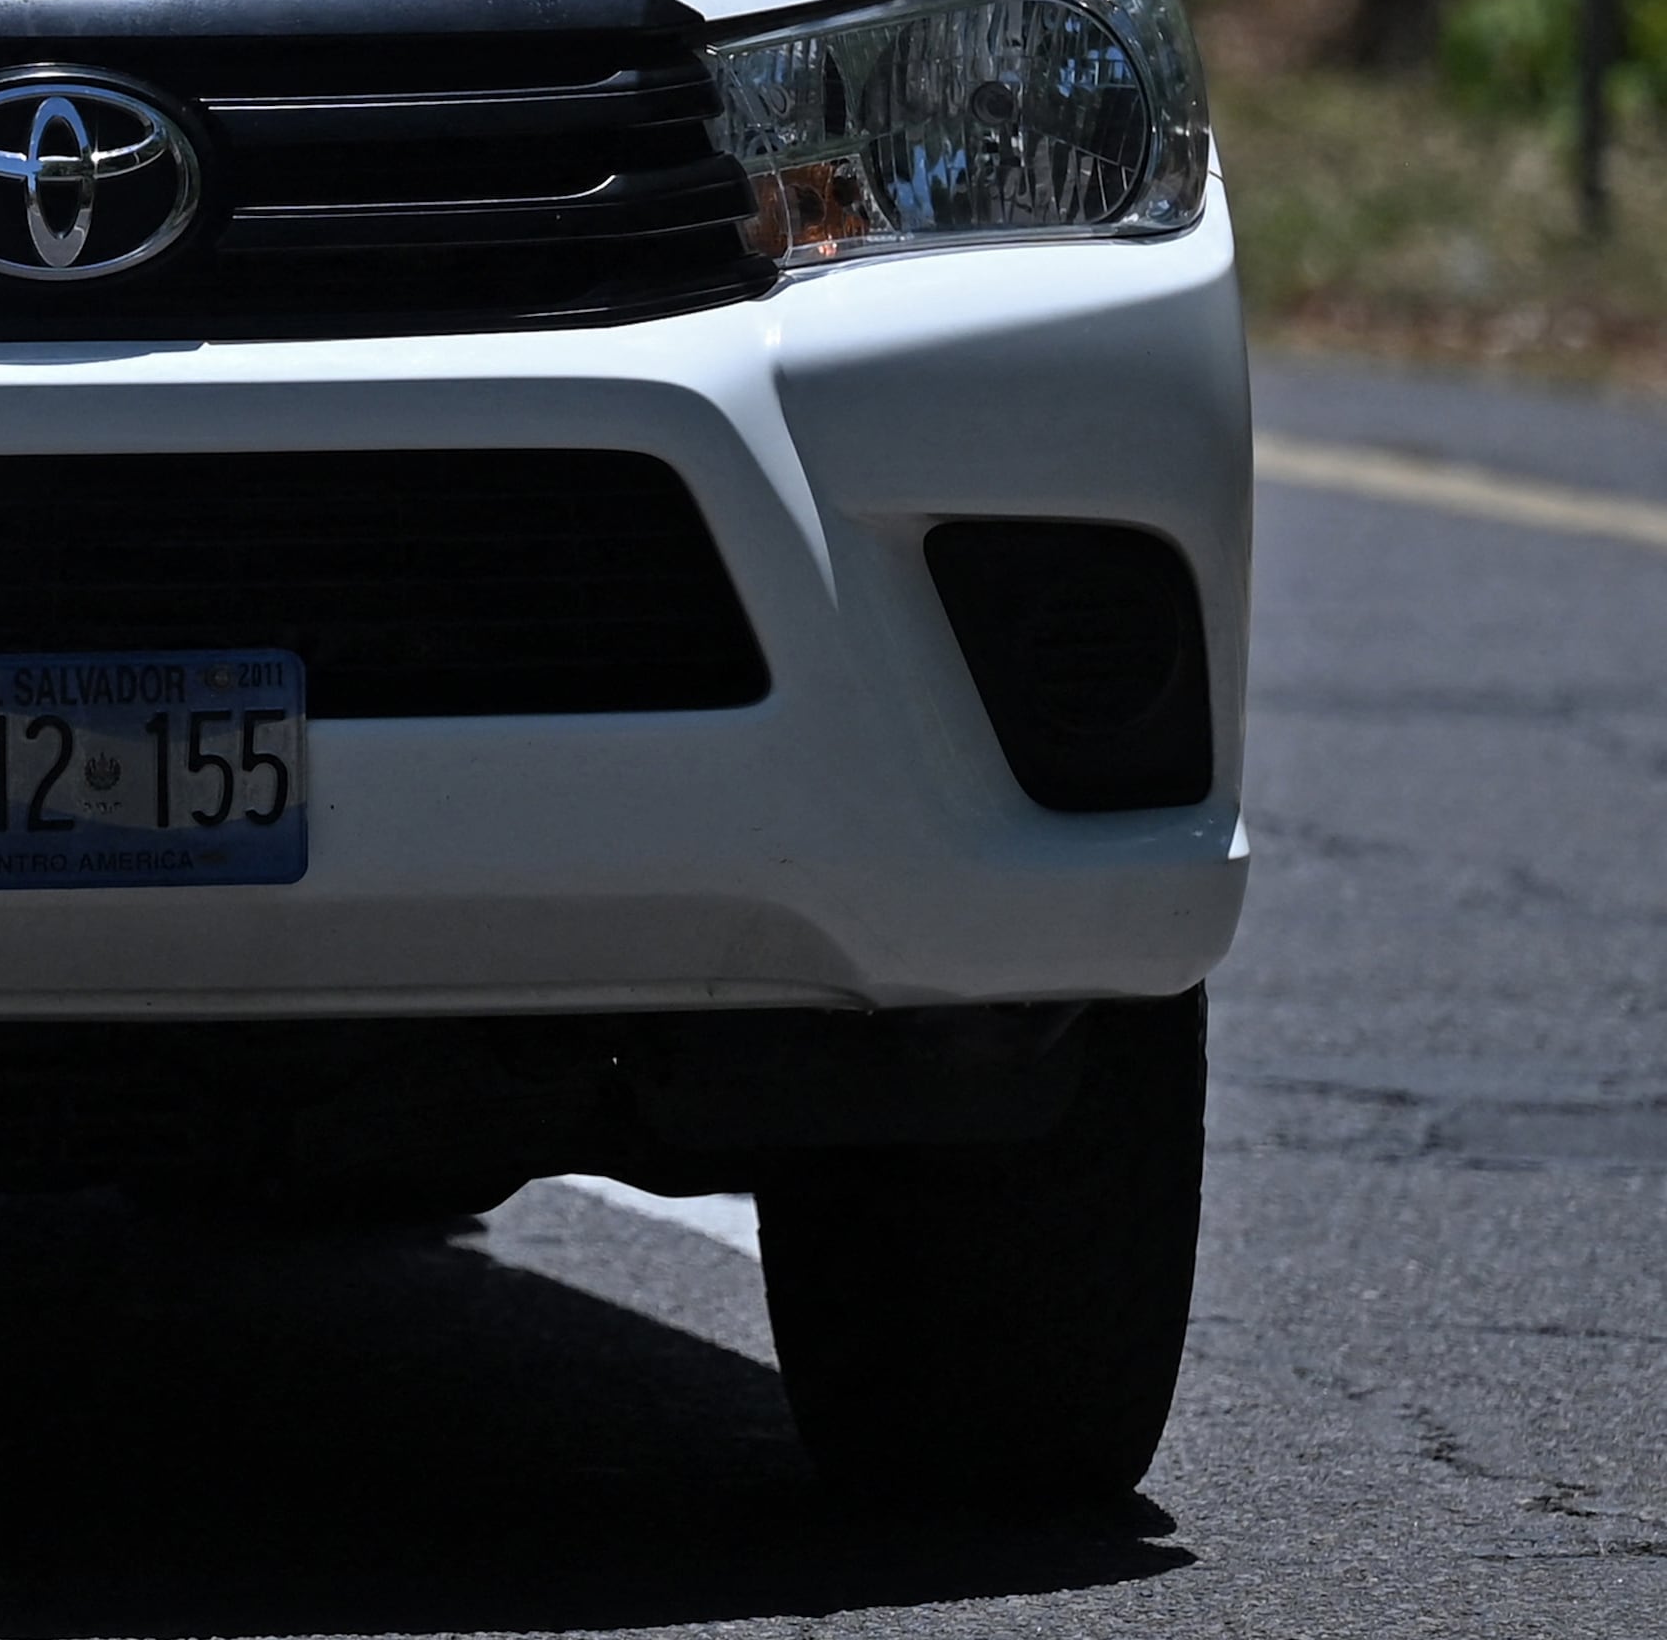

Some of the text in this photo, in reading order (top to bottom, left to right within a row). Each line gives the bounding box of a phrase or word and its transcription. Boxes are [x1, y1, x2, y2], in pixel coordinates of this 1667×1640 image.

[14, 665, 186, 706] SALVADOR
[237, 662, 284, 688] 2011
[145, 709, 290, 829] 155
[78, 849, 195, 874] AMERICA
